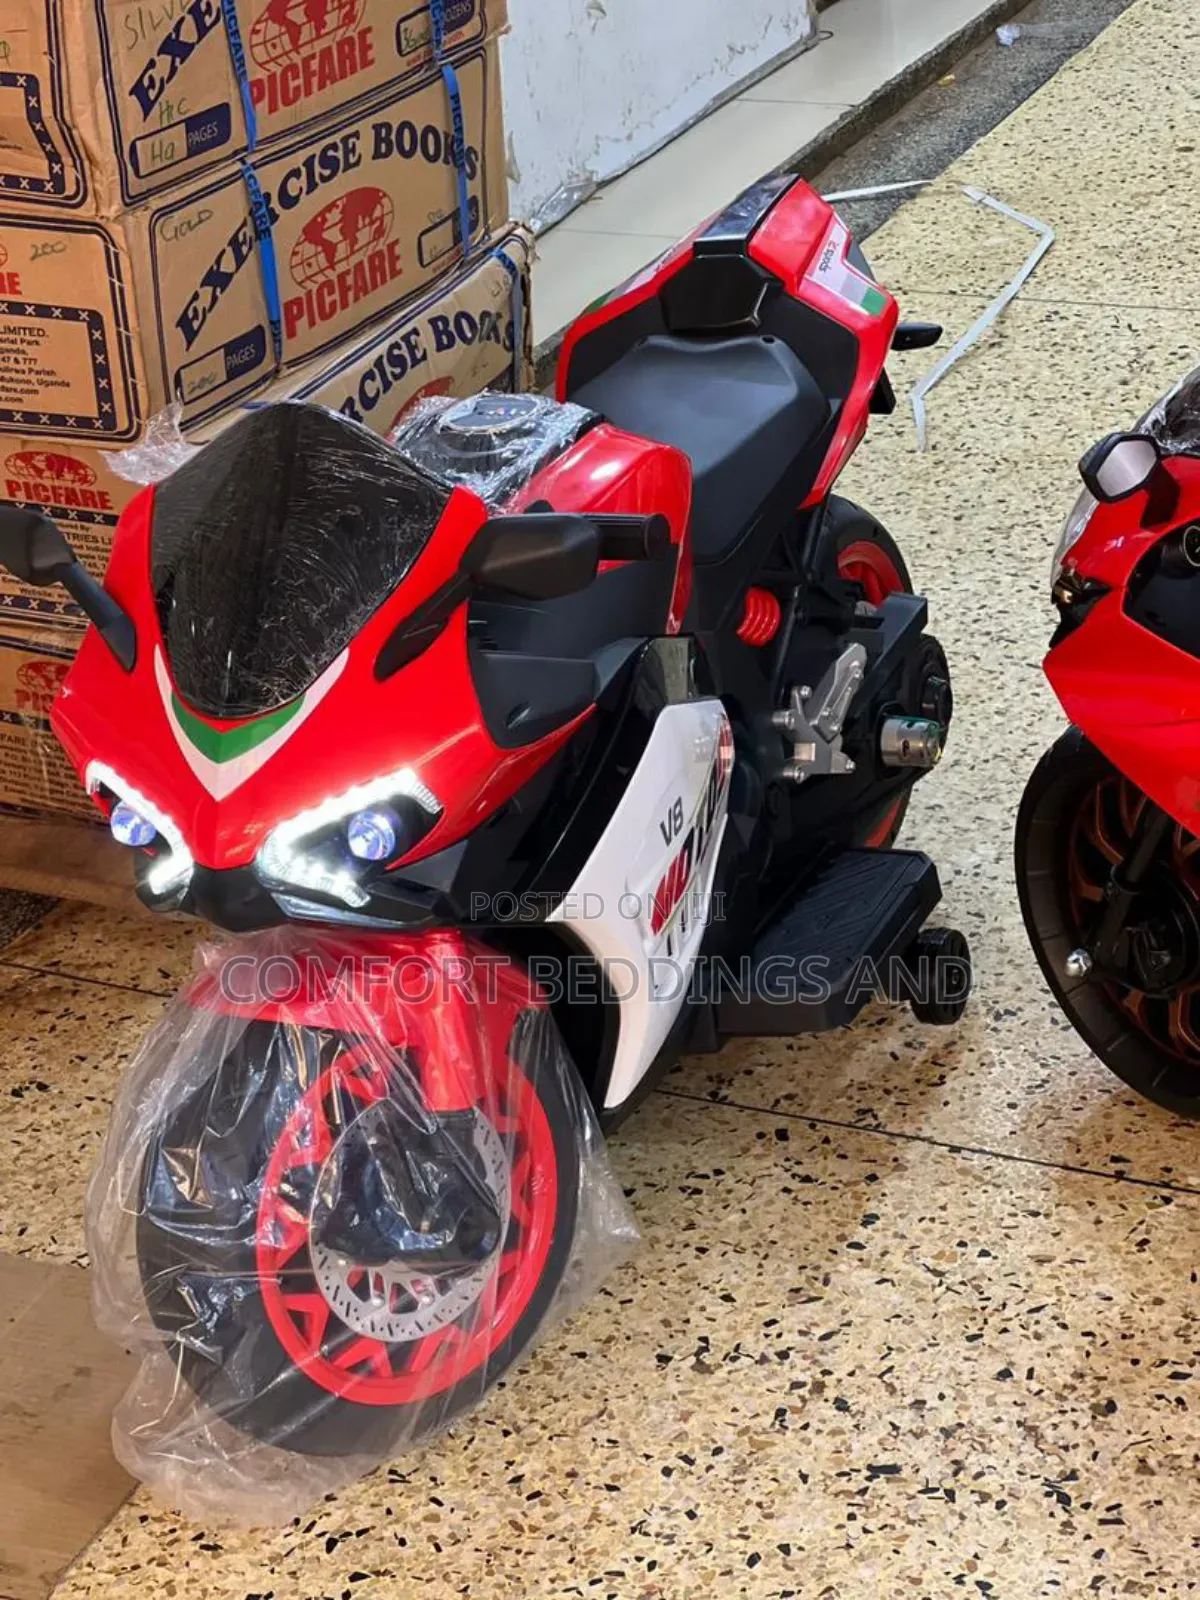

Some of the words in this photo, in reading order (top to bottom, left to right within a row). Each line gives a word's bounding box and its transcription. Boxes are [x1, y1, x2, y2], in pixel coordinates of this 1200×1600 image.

[247, 27, 375, 115] PICFARE
[187, 123, 219, 145] PAGES
[243, 157, 272, 239] ICFARE
[176, 130, 361, 352] EXECISE
[283, 239, 403, 340] PICFARE
[226, 344, 255, 368] PAGES
[4, 479, 114, 511] PICFARE
[660, 797, 684, 848] V8
